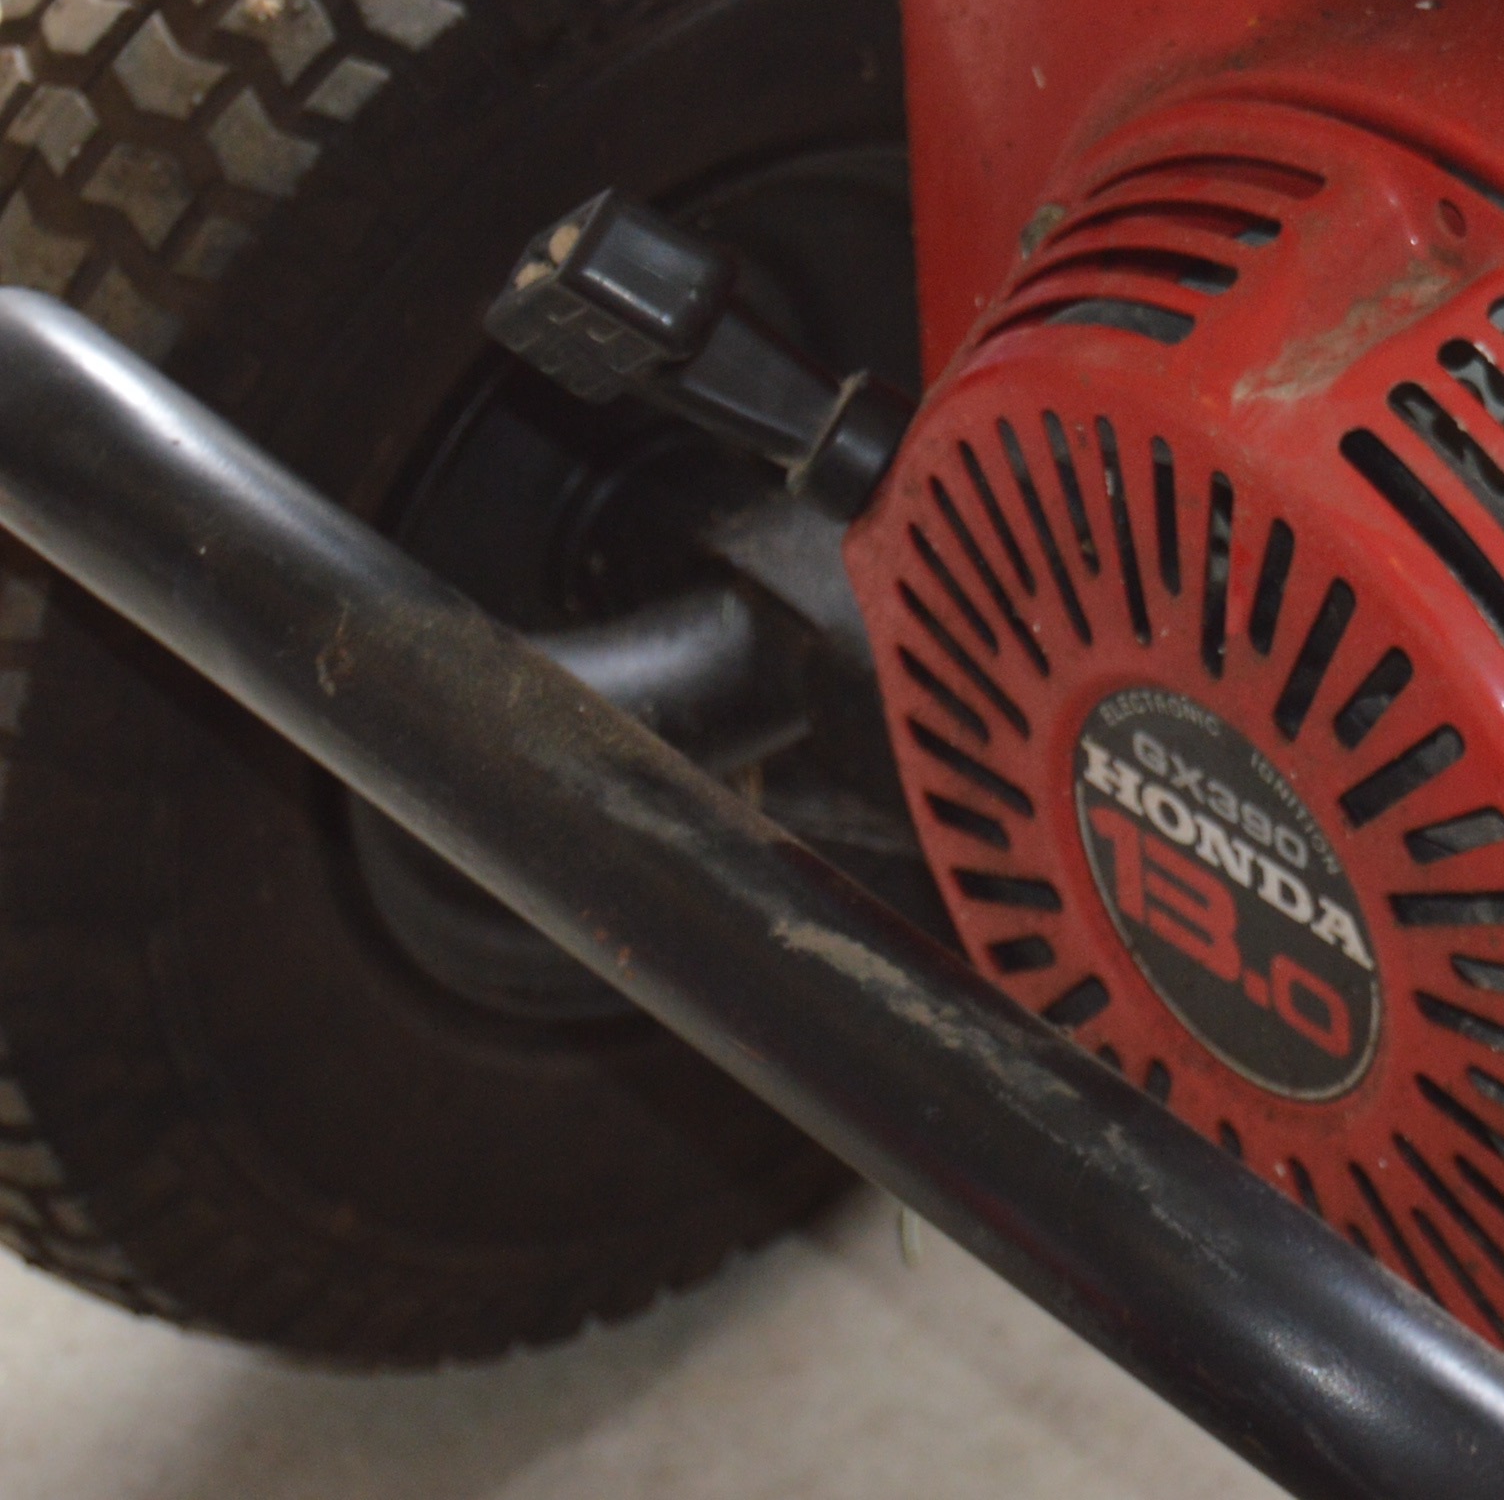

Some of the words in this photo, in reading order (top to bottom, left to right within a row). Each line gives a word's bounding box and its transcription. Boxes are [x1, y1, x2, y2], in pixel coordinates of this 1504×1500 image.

[1081, 736, 1374, 971] HONDA
[1132, 731, 1308, 869] GX390
[1088, 806, 1351, 1057] 13.0
